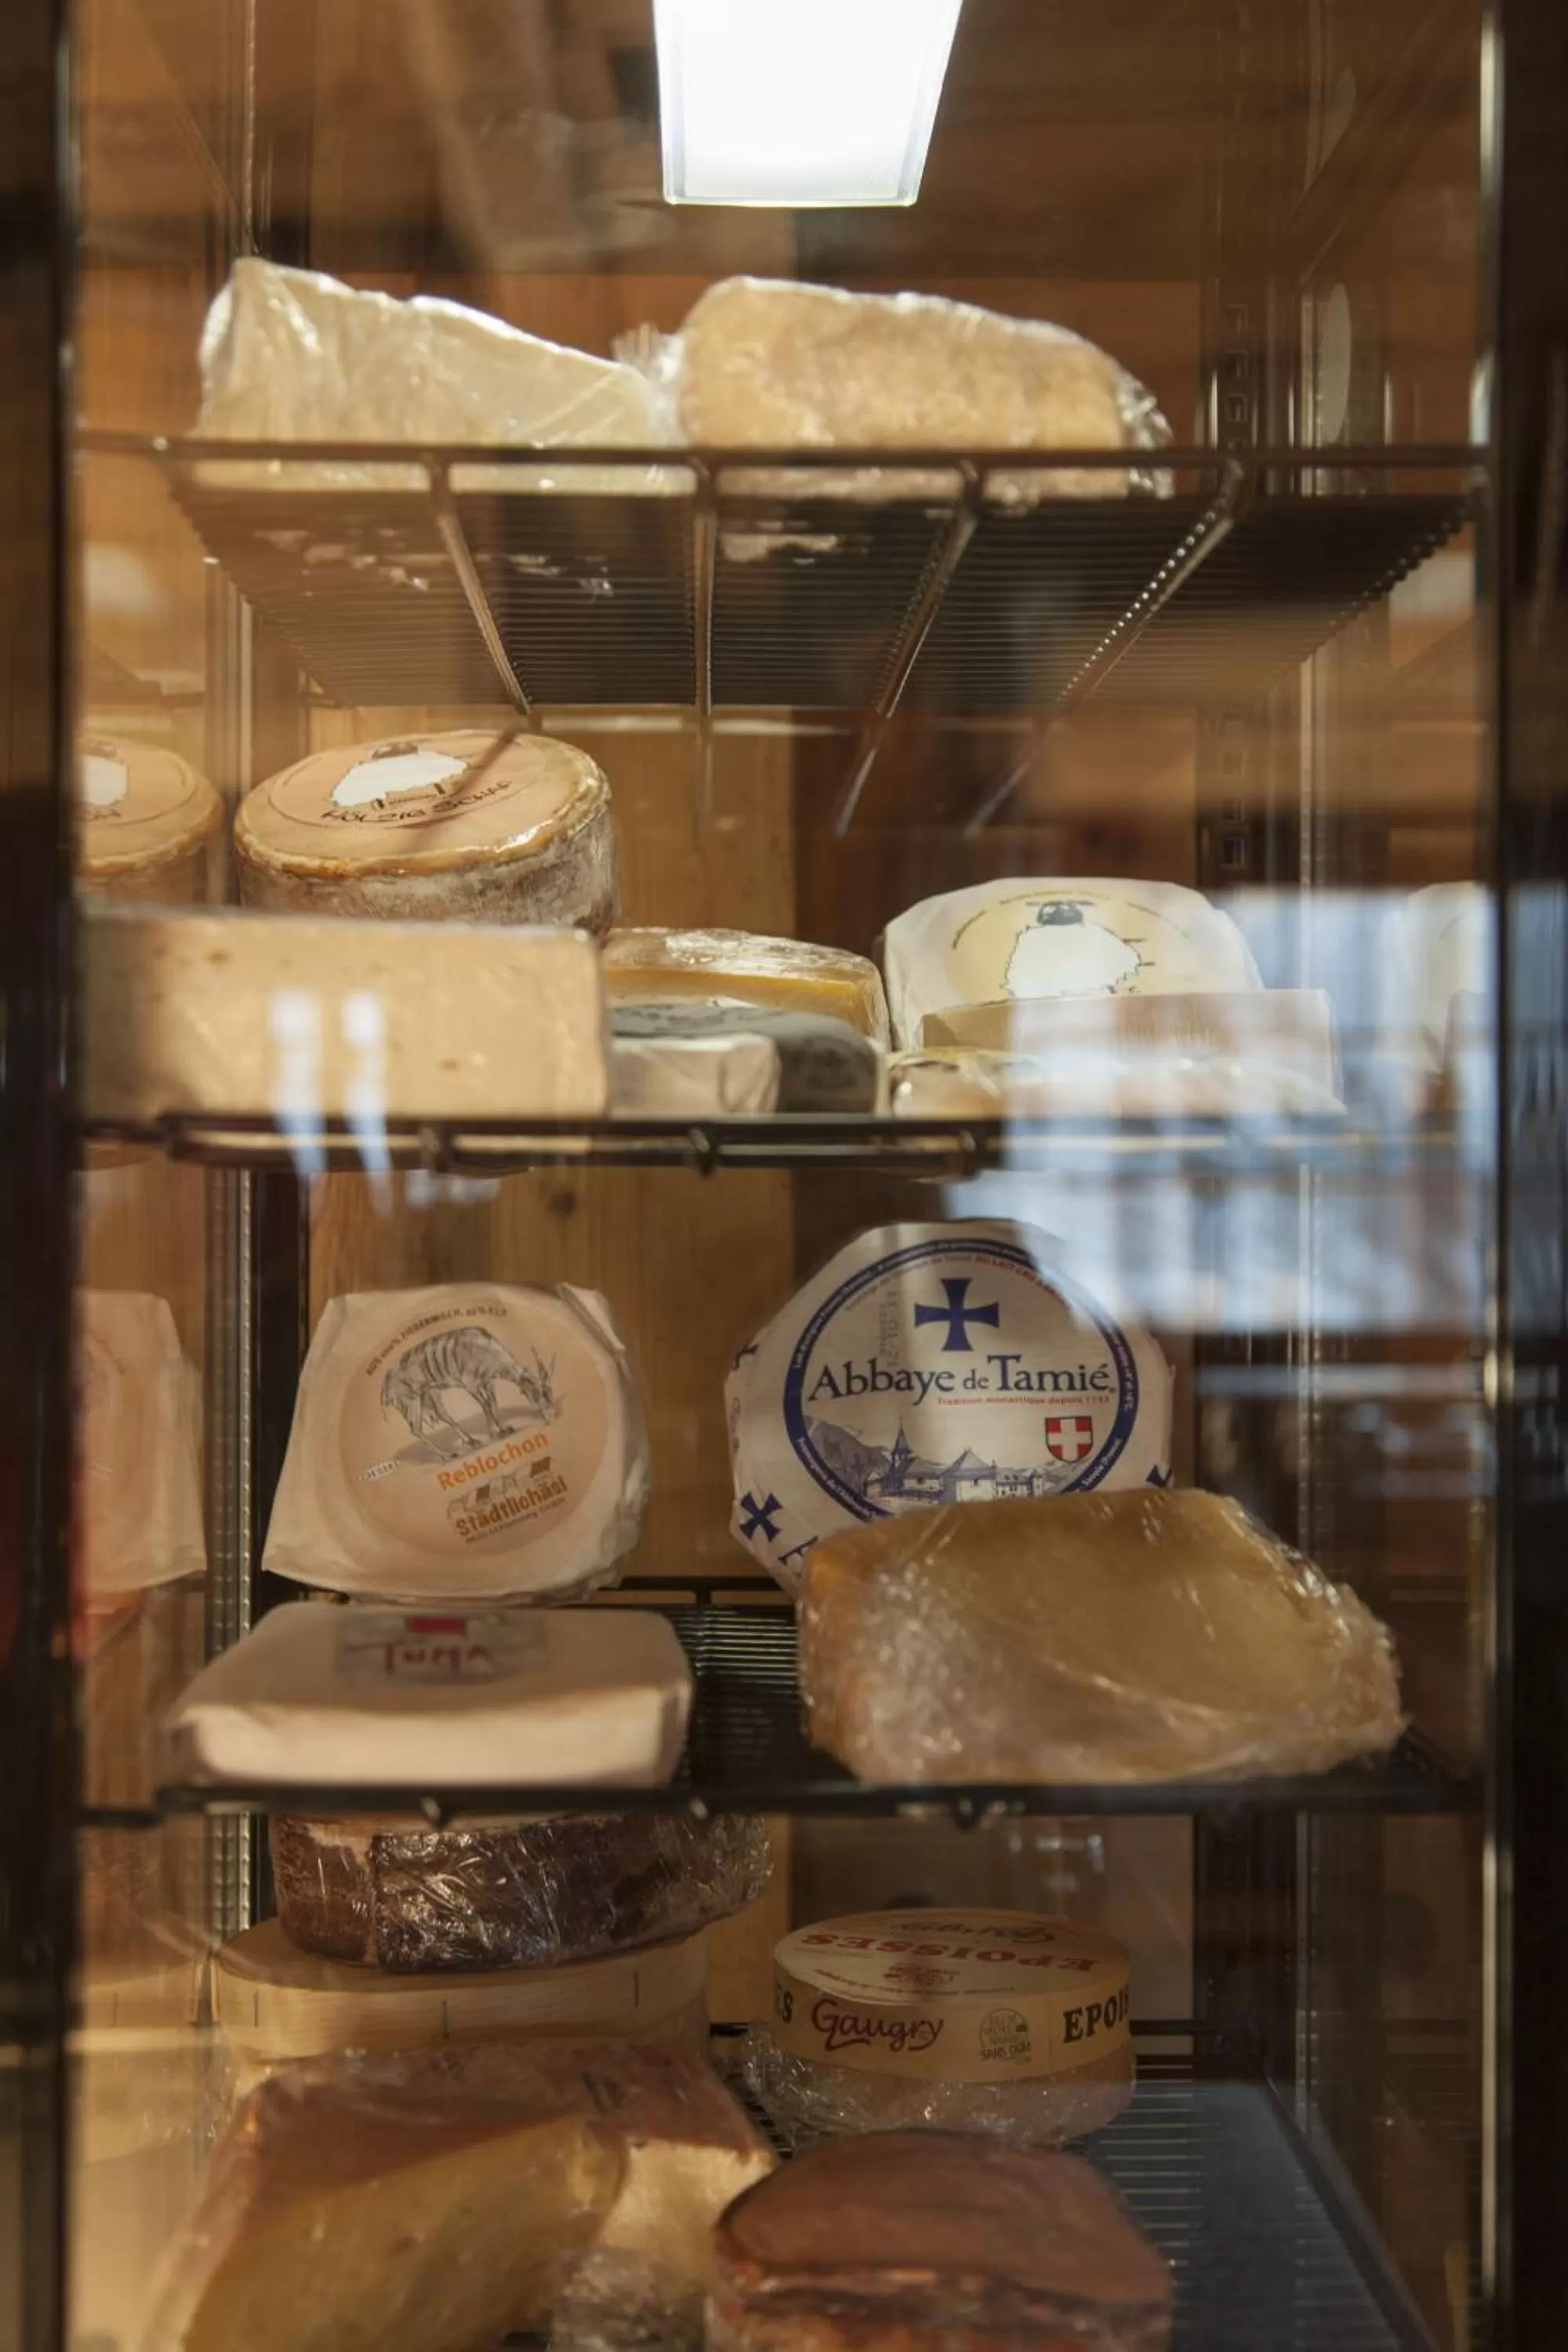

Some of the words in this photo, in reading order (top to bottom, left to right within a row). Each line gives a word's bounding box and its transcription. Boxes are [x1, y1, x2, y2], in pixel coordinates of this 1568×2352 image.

[808, 1358, 955, 1406] Abbaye
[963, 1368, 990, 1390] de
[986, 1354, 1111, 1392] Tamié
[437, 1432, 550, 1491] Reblochon
[800, 1933, 1095, 1972] EPOISSES
[811, 1998, 944, 2052] Gaugry
